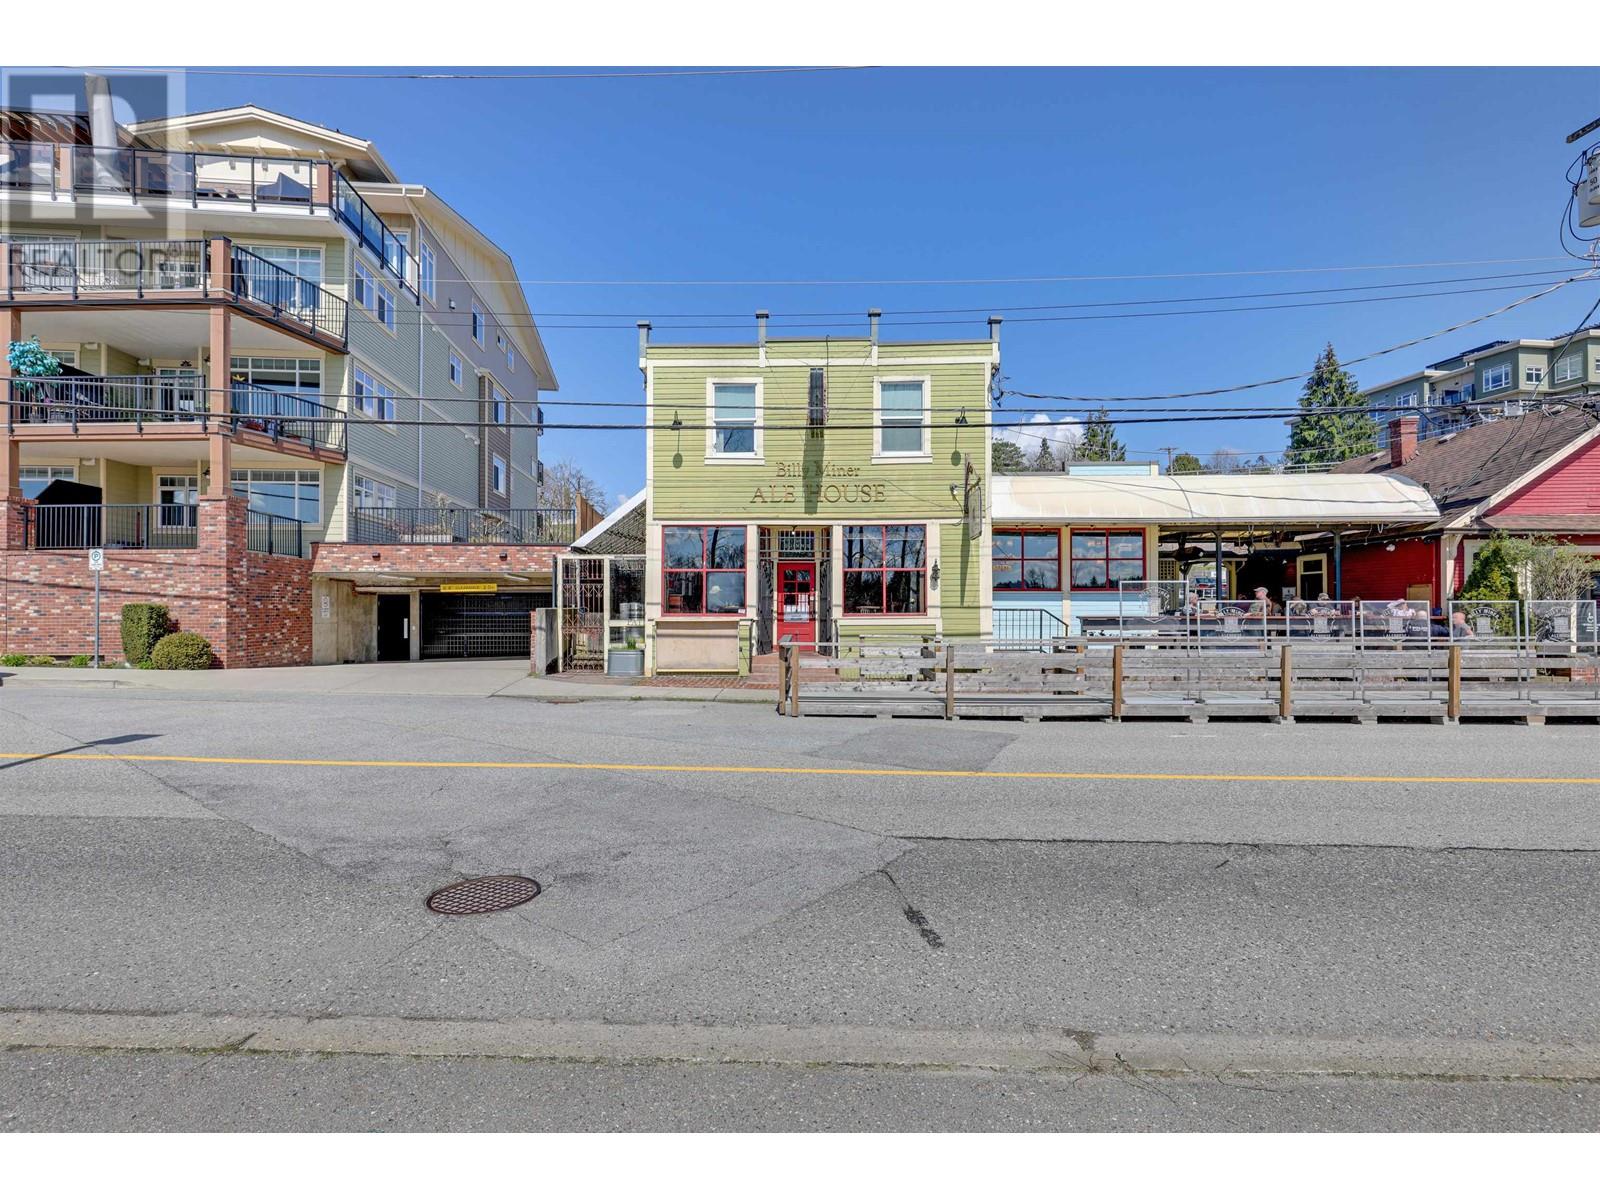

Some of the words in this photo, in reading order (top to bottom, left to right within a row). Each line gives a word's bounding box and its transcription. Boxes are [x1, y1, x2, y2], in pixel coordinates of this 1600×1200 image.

[775, 461, 809, 480] Billy
[814, 461, 860, 478] Miner
[750, 484, 797, 504] ALE
[806, 484, 887, 504] HOUSE
